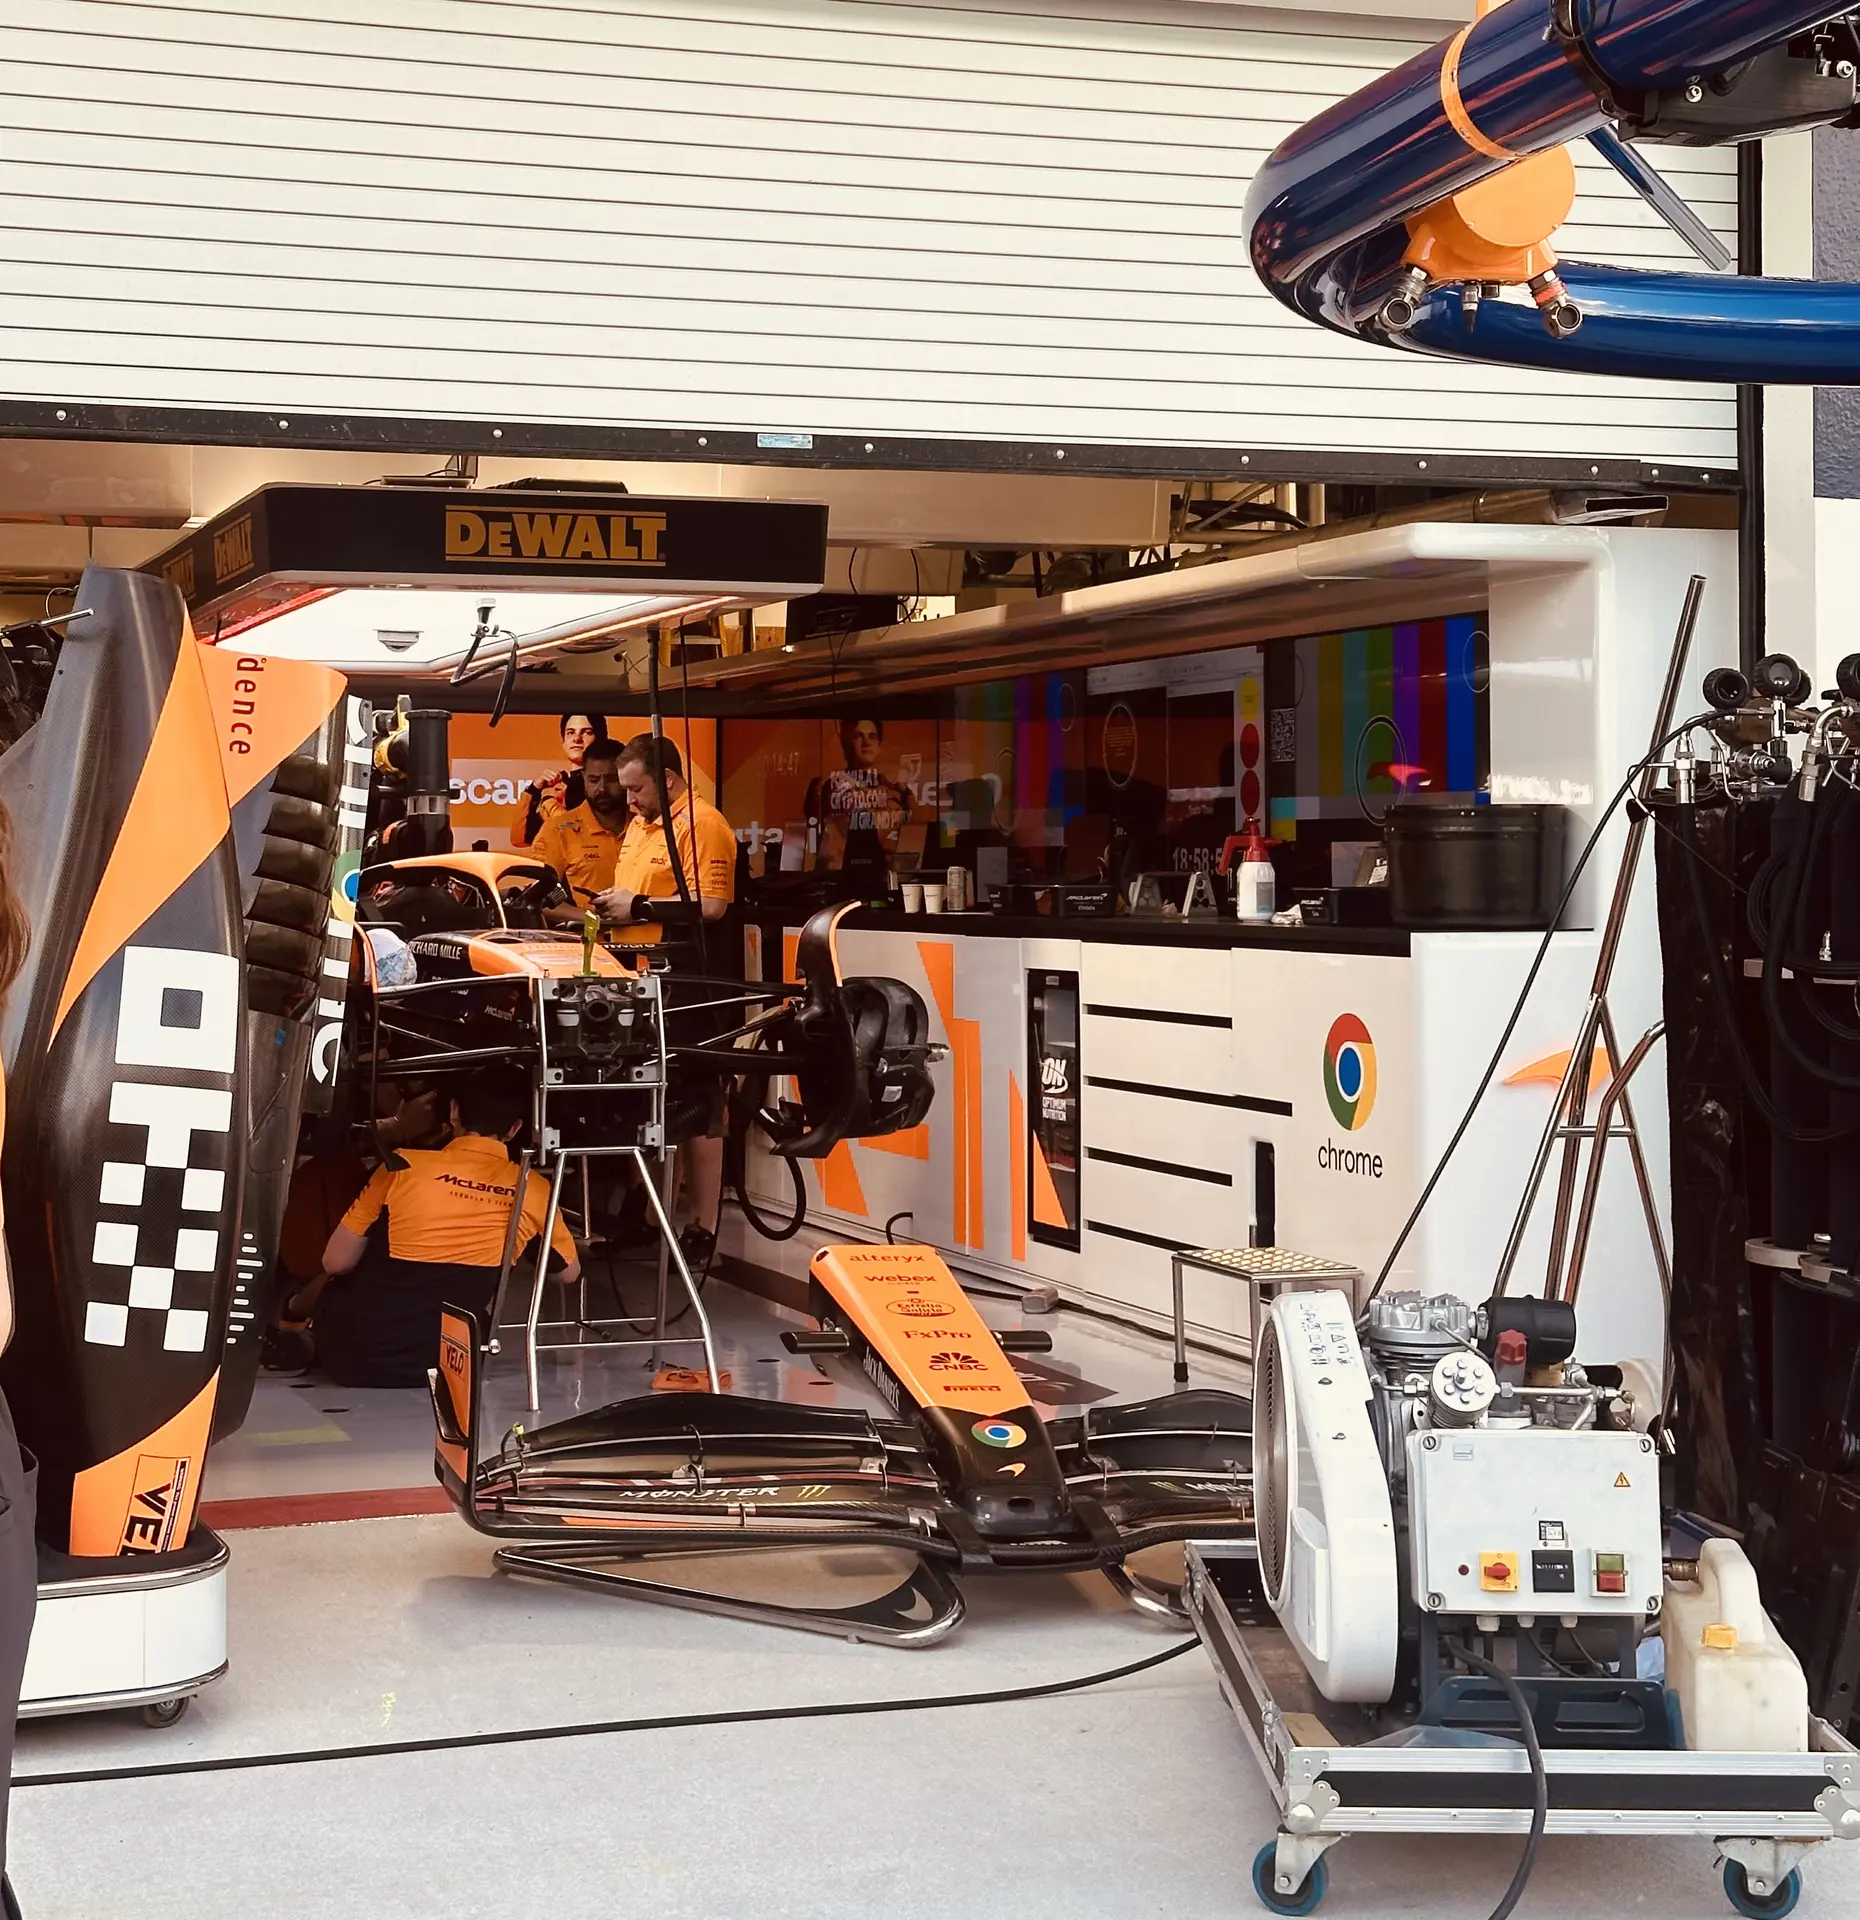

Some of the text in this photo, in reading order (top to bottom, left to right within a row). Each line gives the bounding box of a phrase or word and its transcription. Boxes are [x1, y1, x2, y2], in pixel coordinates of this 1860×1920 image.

[446, 510, 667, 561] DEWALT
[229, 657, 265, 755] dence
[440, 944, 463, 960] MILLE
[1318, 1137, 1383, 1178] chrome
[434, 1173, 516, 1197] McLaren
[849, 1253, 925, 1264] alteryx
[864, 1274, 937, 1283] webex
[903, 1330, 972, 1340] FxPro
[928, 1364, 989, 1372] CNBC
[943, 1384, 1002, 1393] PIRELLI
